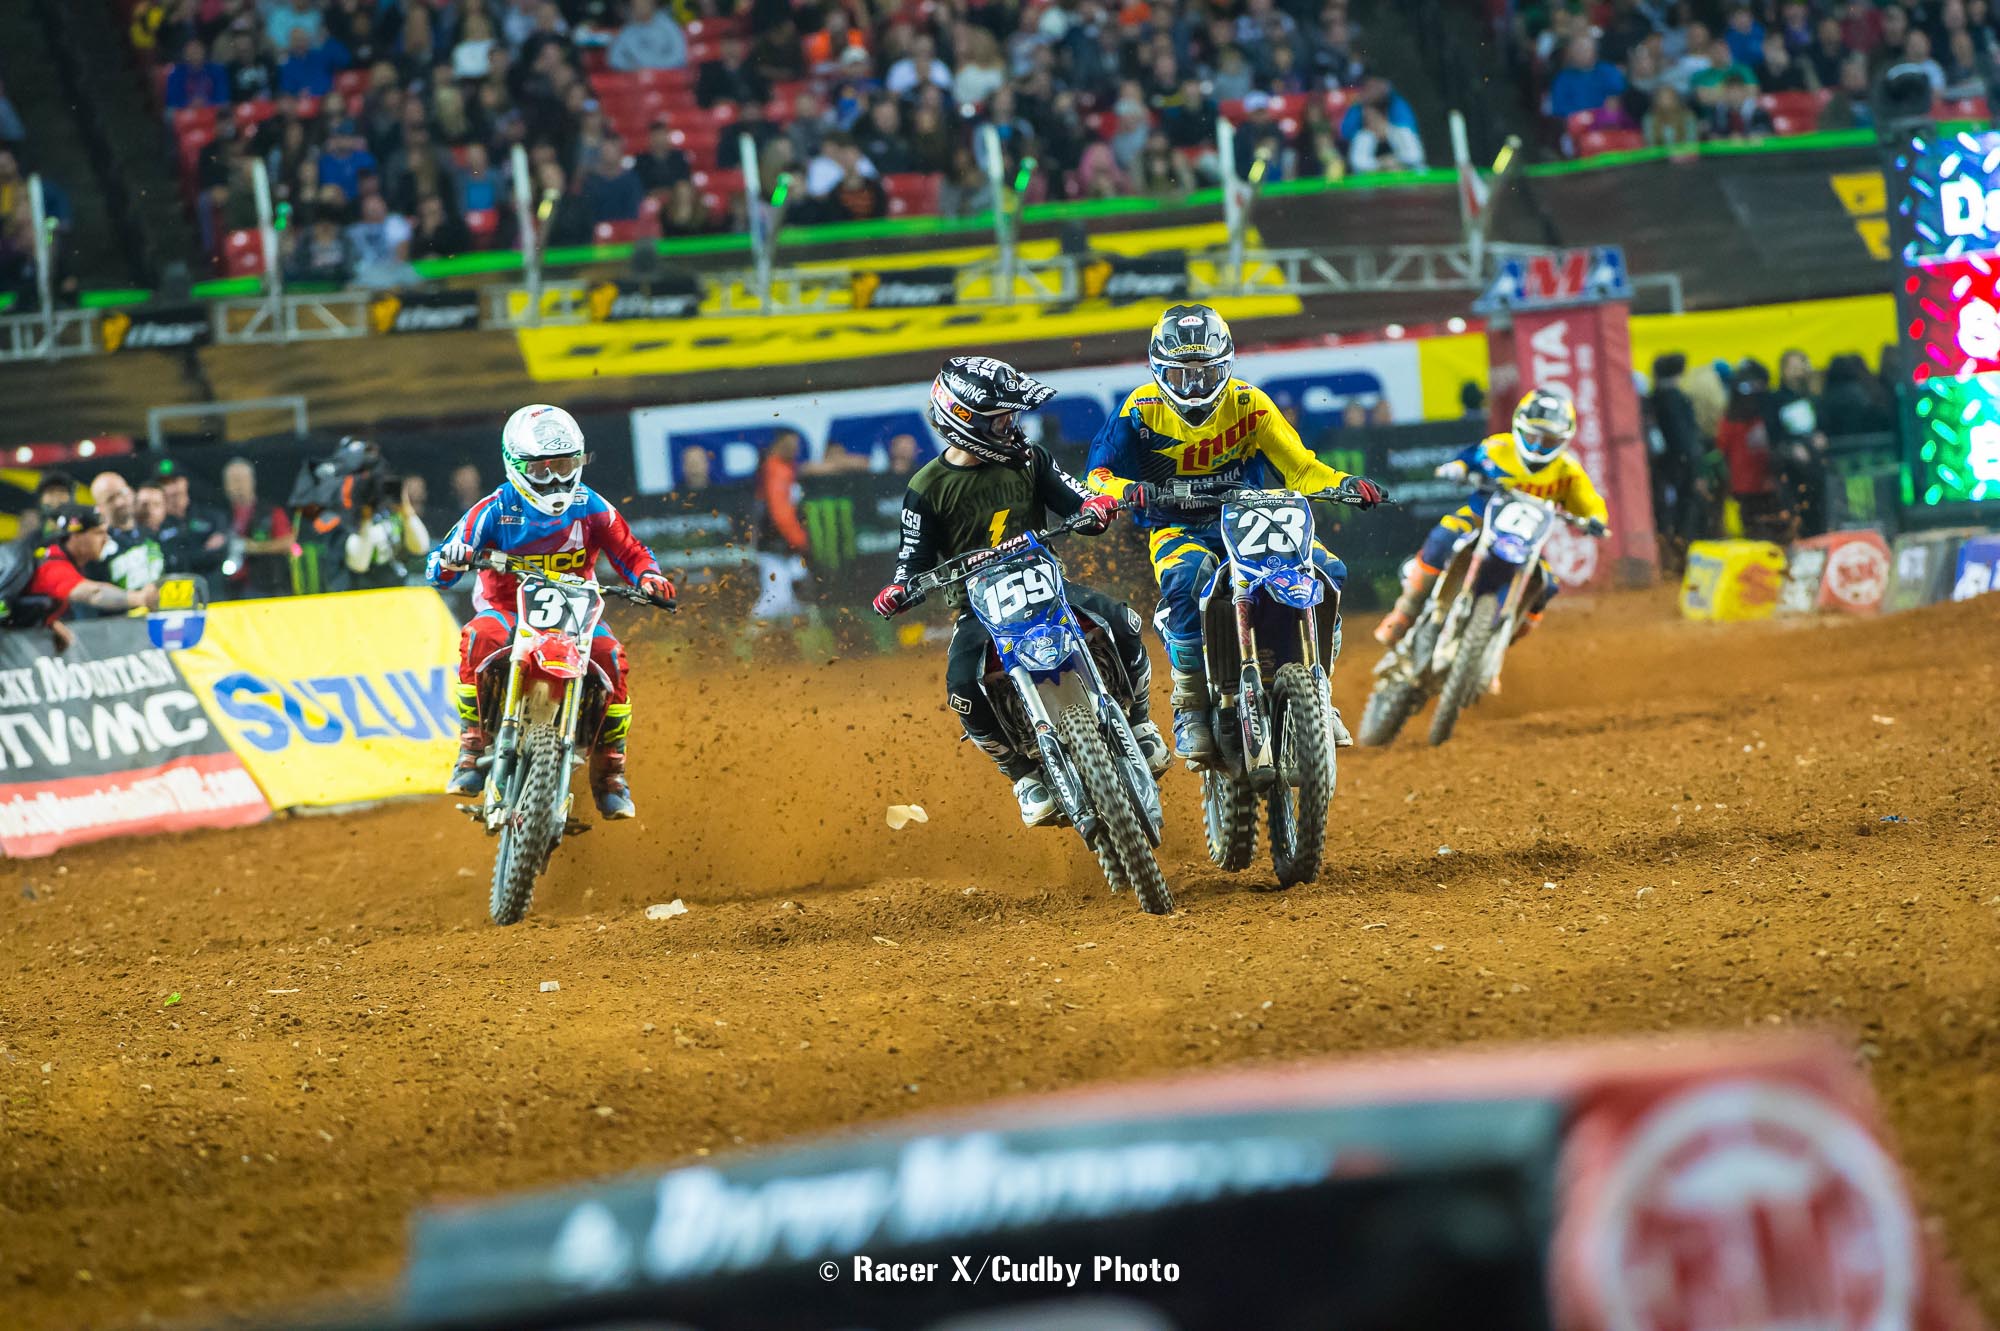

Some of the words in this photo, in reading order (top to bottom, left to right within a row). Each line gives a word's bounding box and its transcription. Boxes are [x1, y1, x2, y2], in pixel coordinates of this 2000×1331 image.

[1490, 248, 1627, 298] AMA
[947, 431, 1012, 464] FASTHOUSE
[901, 508, 921, 530] 159
[1237, 507, 1307, 557] 23
[507, 548, 587, 573] GEICO
[983, 563, 1056, 625] 159
[213, 666, 459, 753] SUZUK
